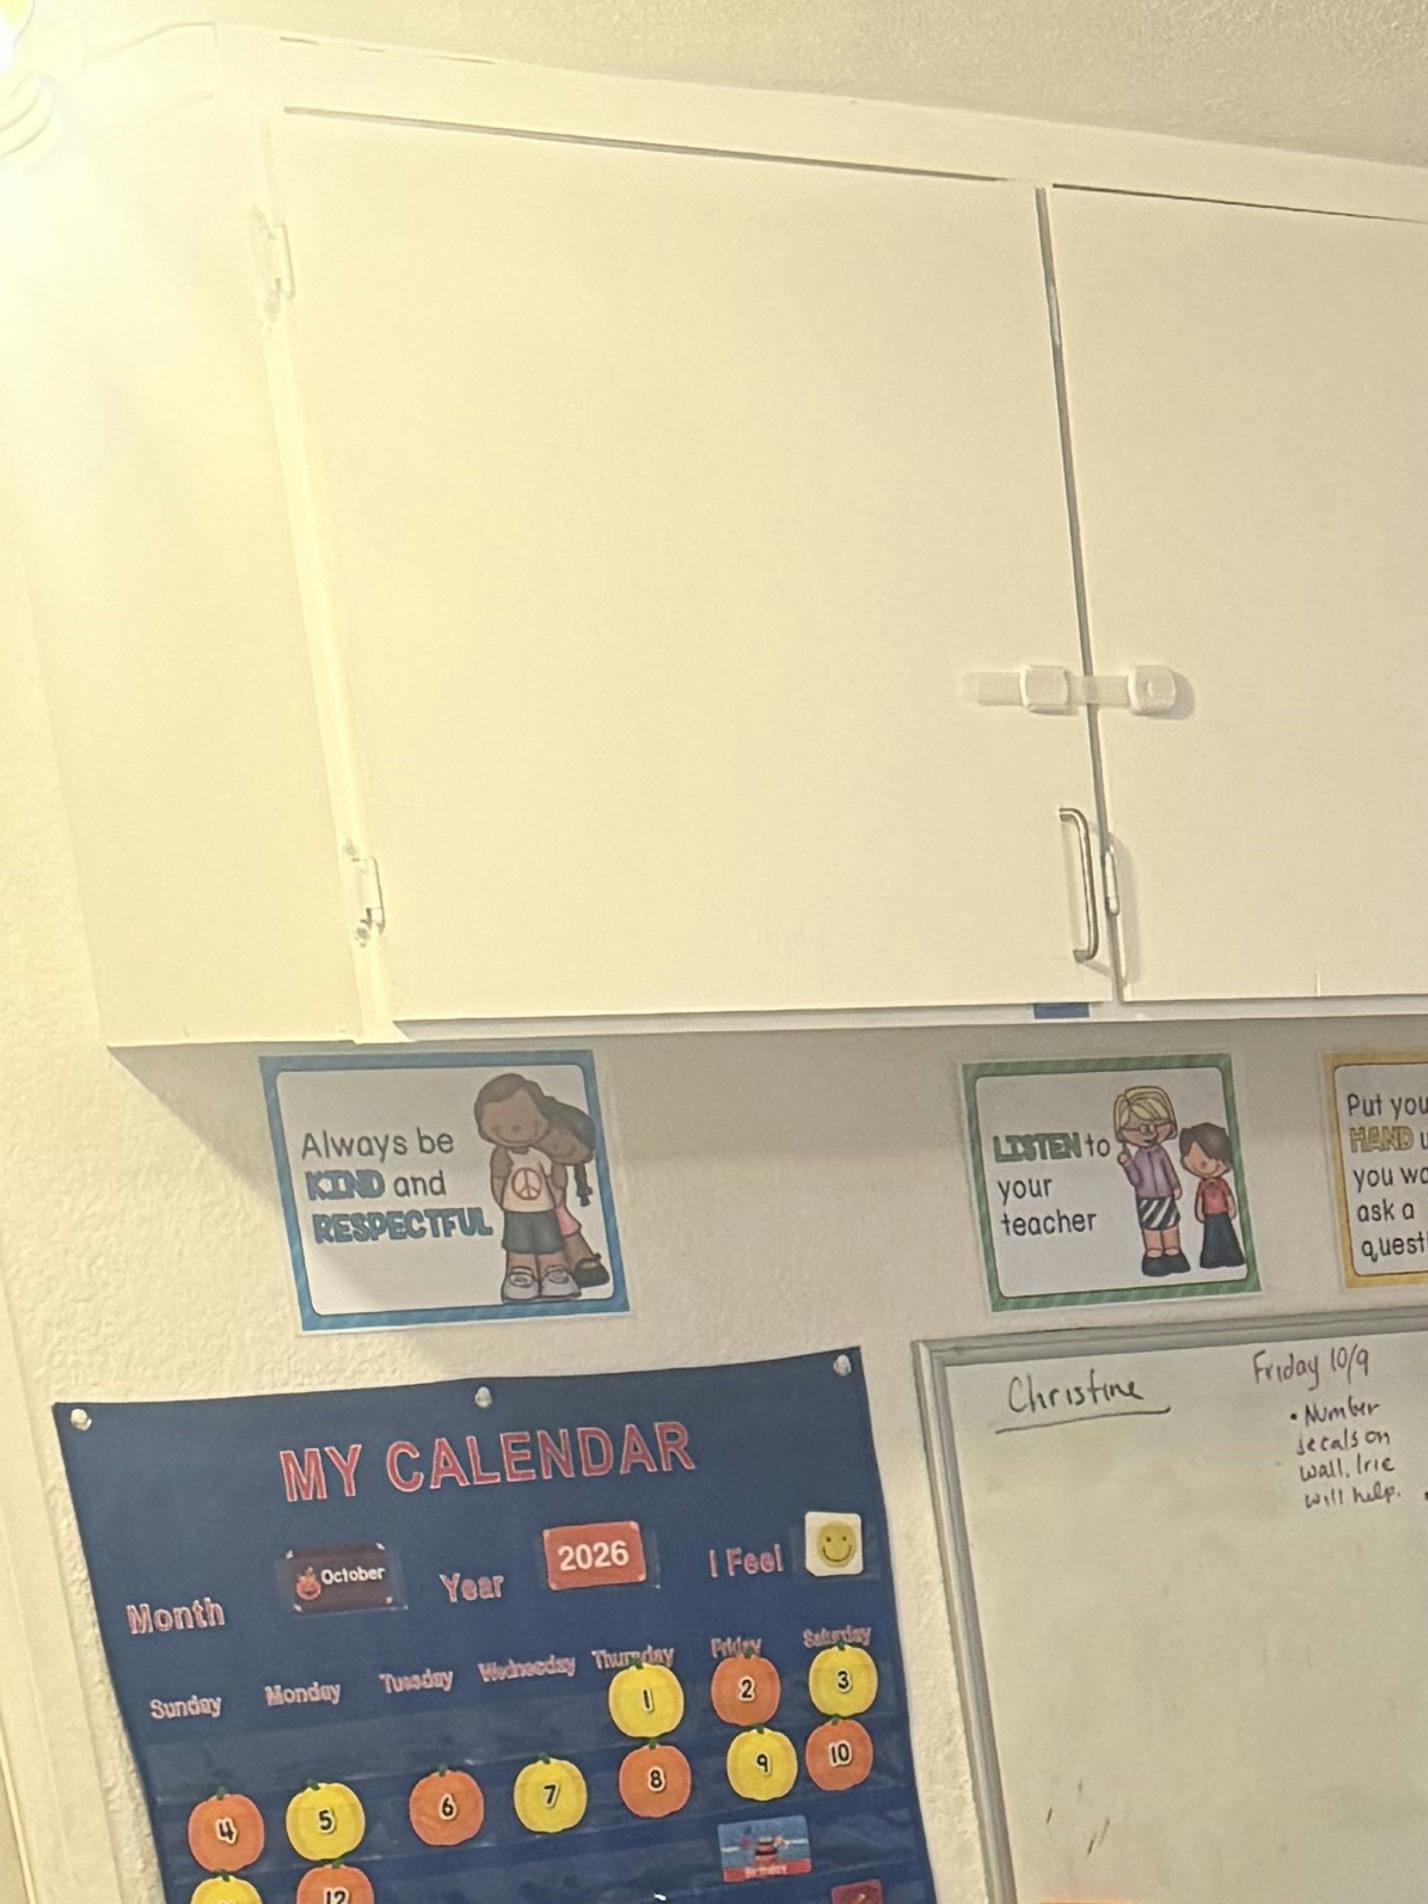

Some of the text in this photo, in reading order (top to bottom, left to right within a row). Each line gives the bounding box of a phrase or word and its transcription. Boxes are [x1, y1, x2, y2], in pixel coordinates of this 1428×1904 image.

[1347, 1094, 1385, 1116] Put
[302, 1127, 454, 1162] Always be
[992, 1133, 1110, 1164] LISTEN to
[1350, 1128, 1414, 1153] HAND
[306, 1169, 446, 1200] KIND and
[997, 1177, 1053, 1200] your
[1354, 1166, 1394, 1188] you
[313, 1207, 493, 1243] RESPECTFUL
[1001, 1210, 1097, 1238] teacher
[1358, 1202, 1414, 1222] ask a
[1253, 1344, 1369, 1391] Friday 10/9
[1008, 1369, 1144, 1414] Christine
[1365, 1430, 1390, 1445] on
[279, 1420, 696, 1503] MY CALENDAR
[1305, 1490, 1343, 1509] will
[558, 1540, 629, 1571] 2026
[710, 1543, 784, 1576] I Feel
[321, 1562, 386, 1584] October
[440, 1572, 504, 1602] Year
[126, 1598, 225, 1635] Month
[150, 1691, 222, 1720] Sunday
[265, 1679, 341, 1709] Monday
[379, 1667, 454, 1694] Tuesday
[478, 1653, 576, 1682] Wednesday
[643, 1671, 849, 1711] 1 2 3
[217, 1744, 850, 1844] 4 5 6 7 8 9 10
